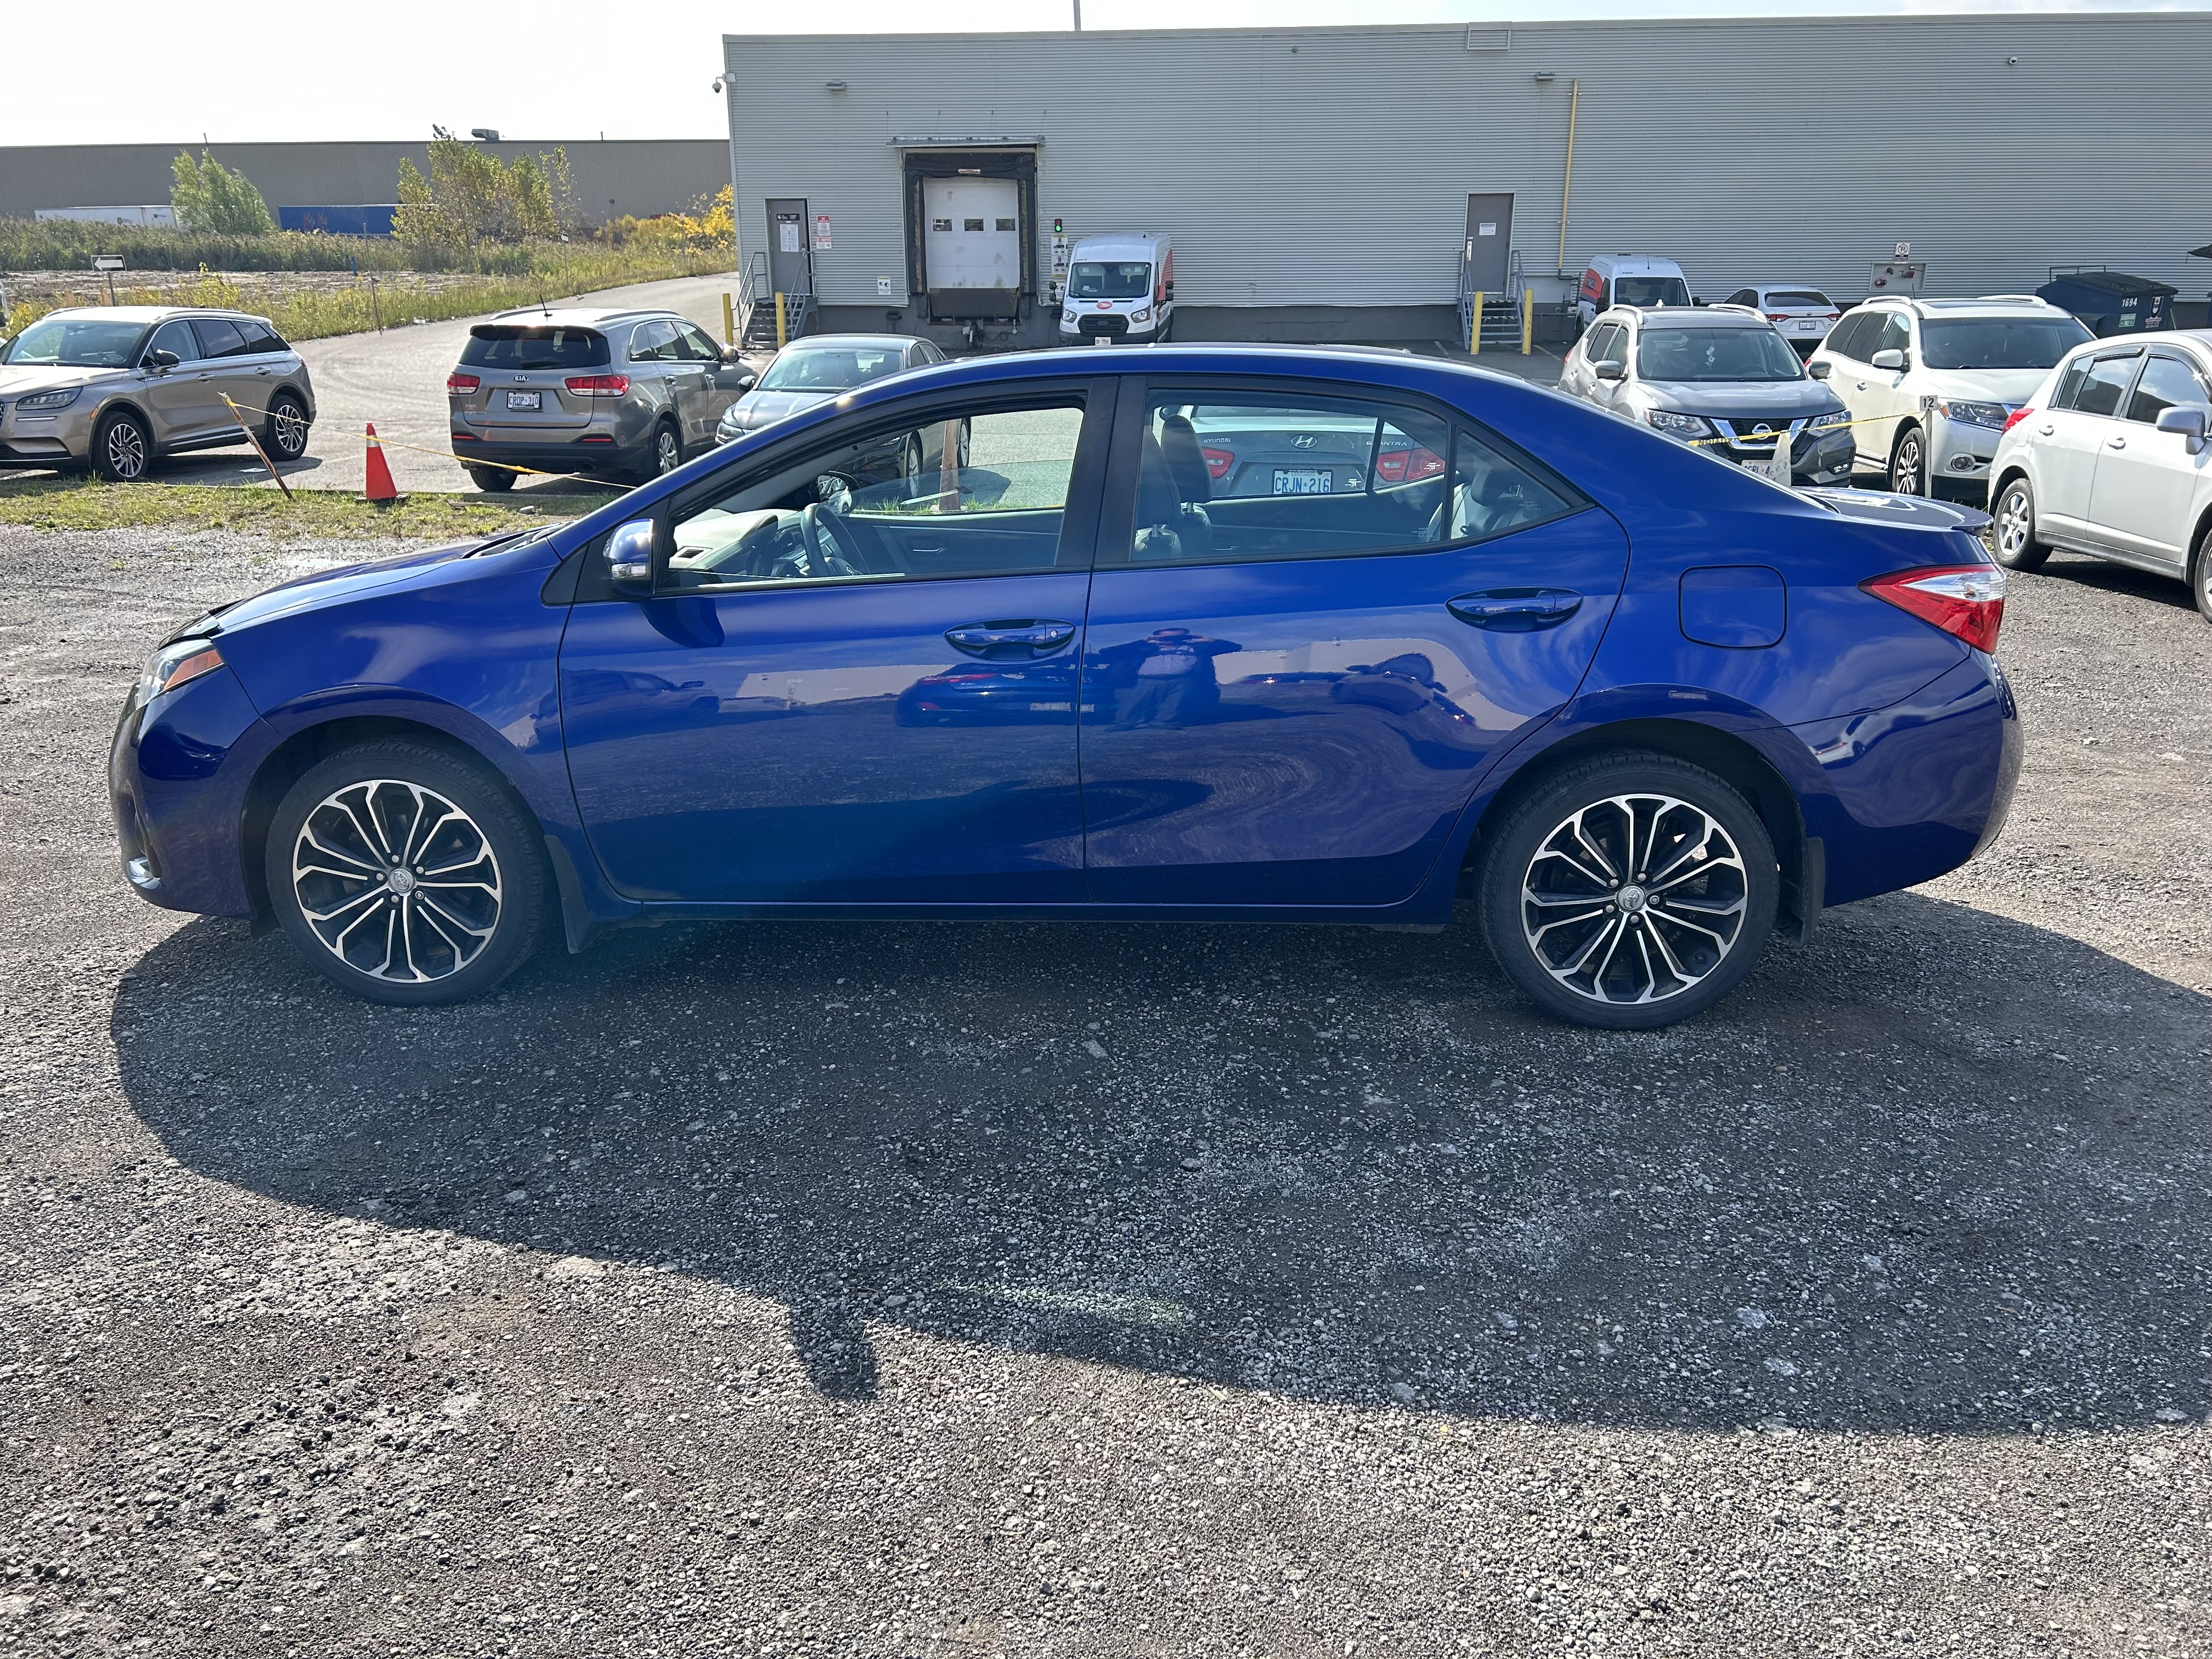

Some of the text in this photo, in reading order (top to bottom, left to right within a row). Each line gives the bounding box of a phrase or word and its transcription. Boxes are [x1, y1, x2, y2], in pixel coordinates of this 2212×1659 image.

[2122, 297, 2137, 307] 1694
[1923, 397, 1934, 408] 12
[1275, 477, 1302, 492] CRJN
[1309, 478, 1330, 492] 216
